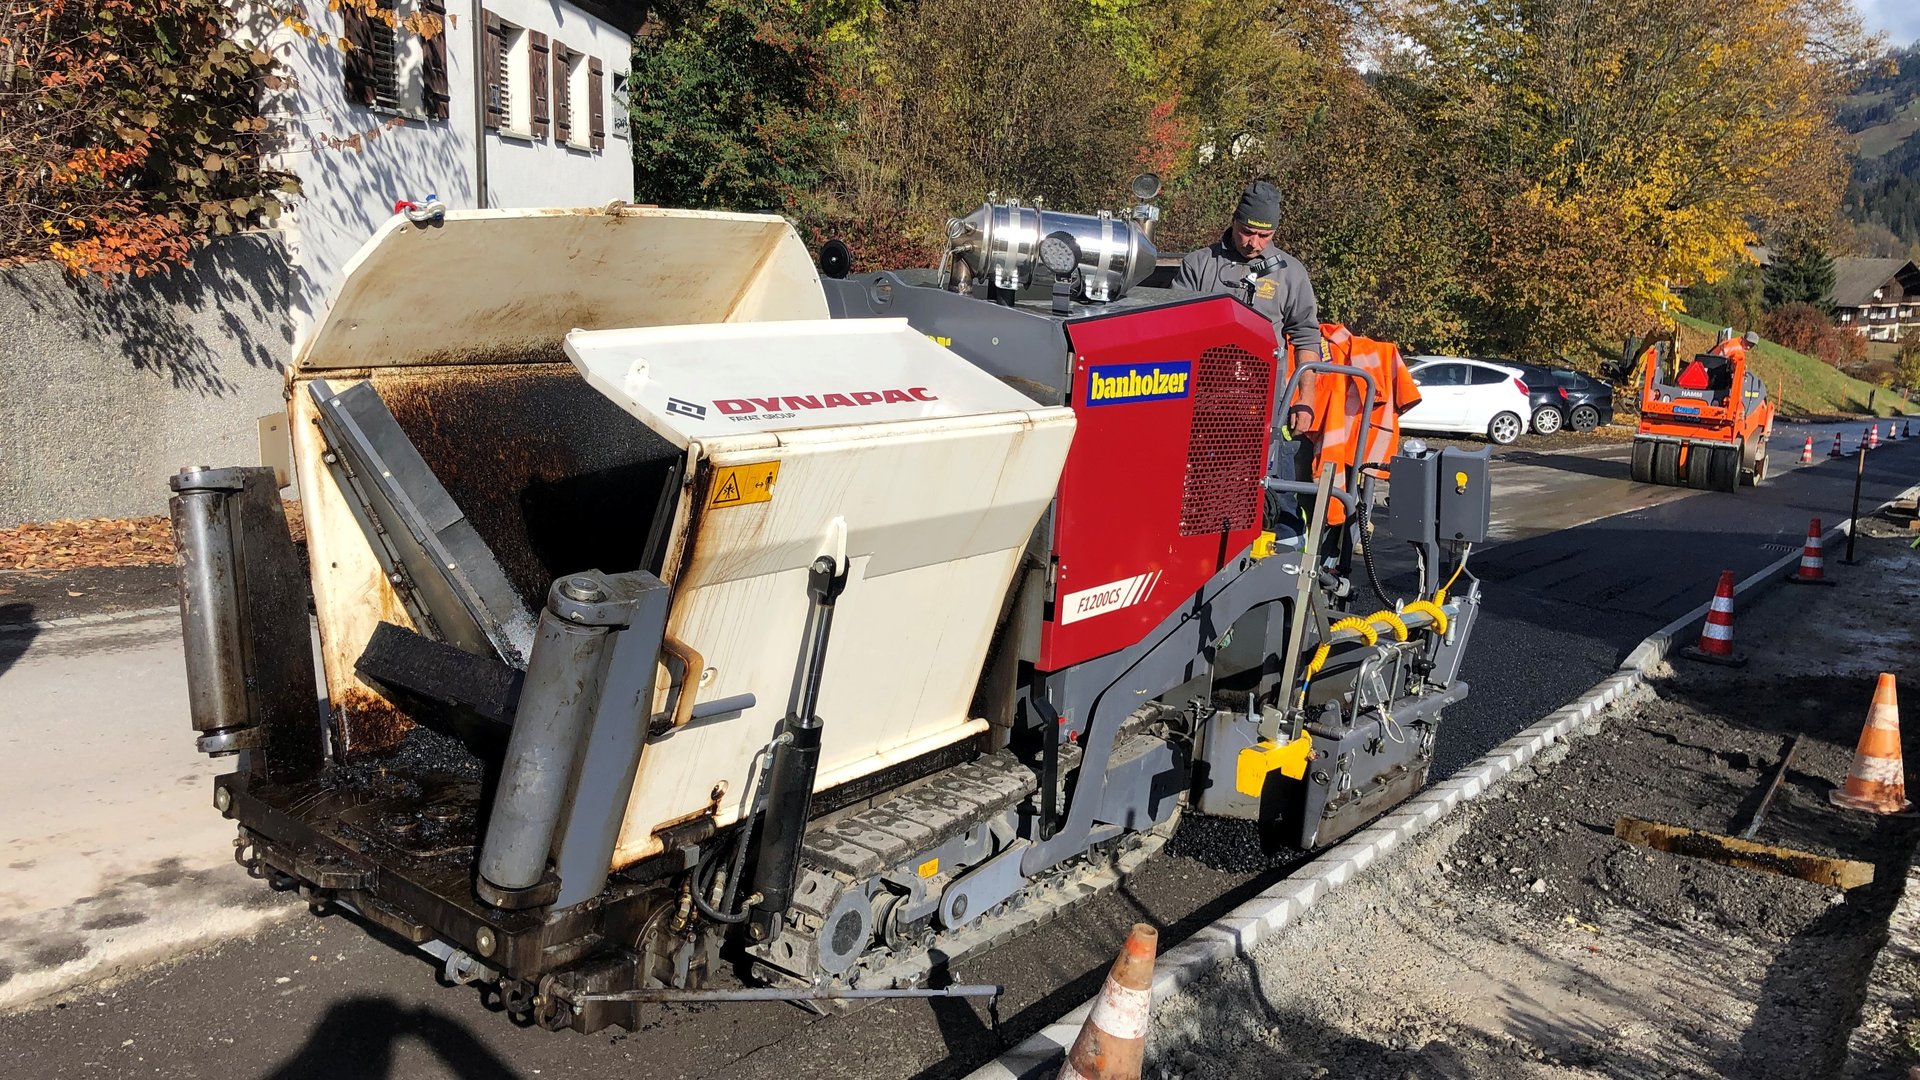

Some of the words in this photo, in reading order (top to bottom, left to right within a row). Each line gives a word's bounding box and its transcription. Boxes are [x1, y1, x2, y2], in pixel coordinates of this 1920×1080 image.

[1091, 369, 1188, 400] banholzer
[1681, 390, 1703, 398] HAMM
[712, 387, 938, 415] DYNAPAC
[729, 413, 760, 422] FAYAT
[762, 412, 796, 420] GROUP
[1077, 586, 1122, 614] F1200CS
